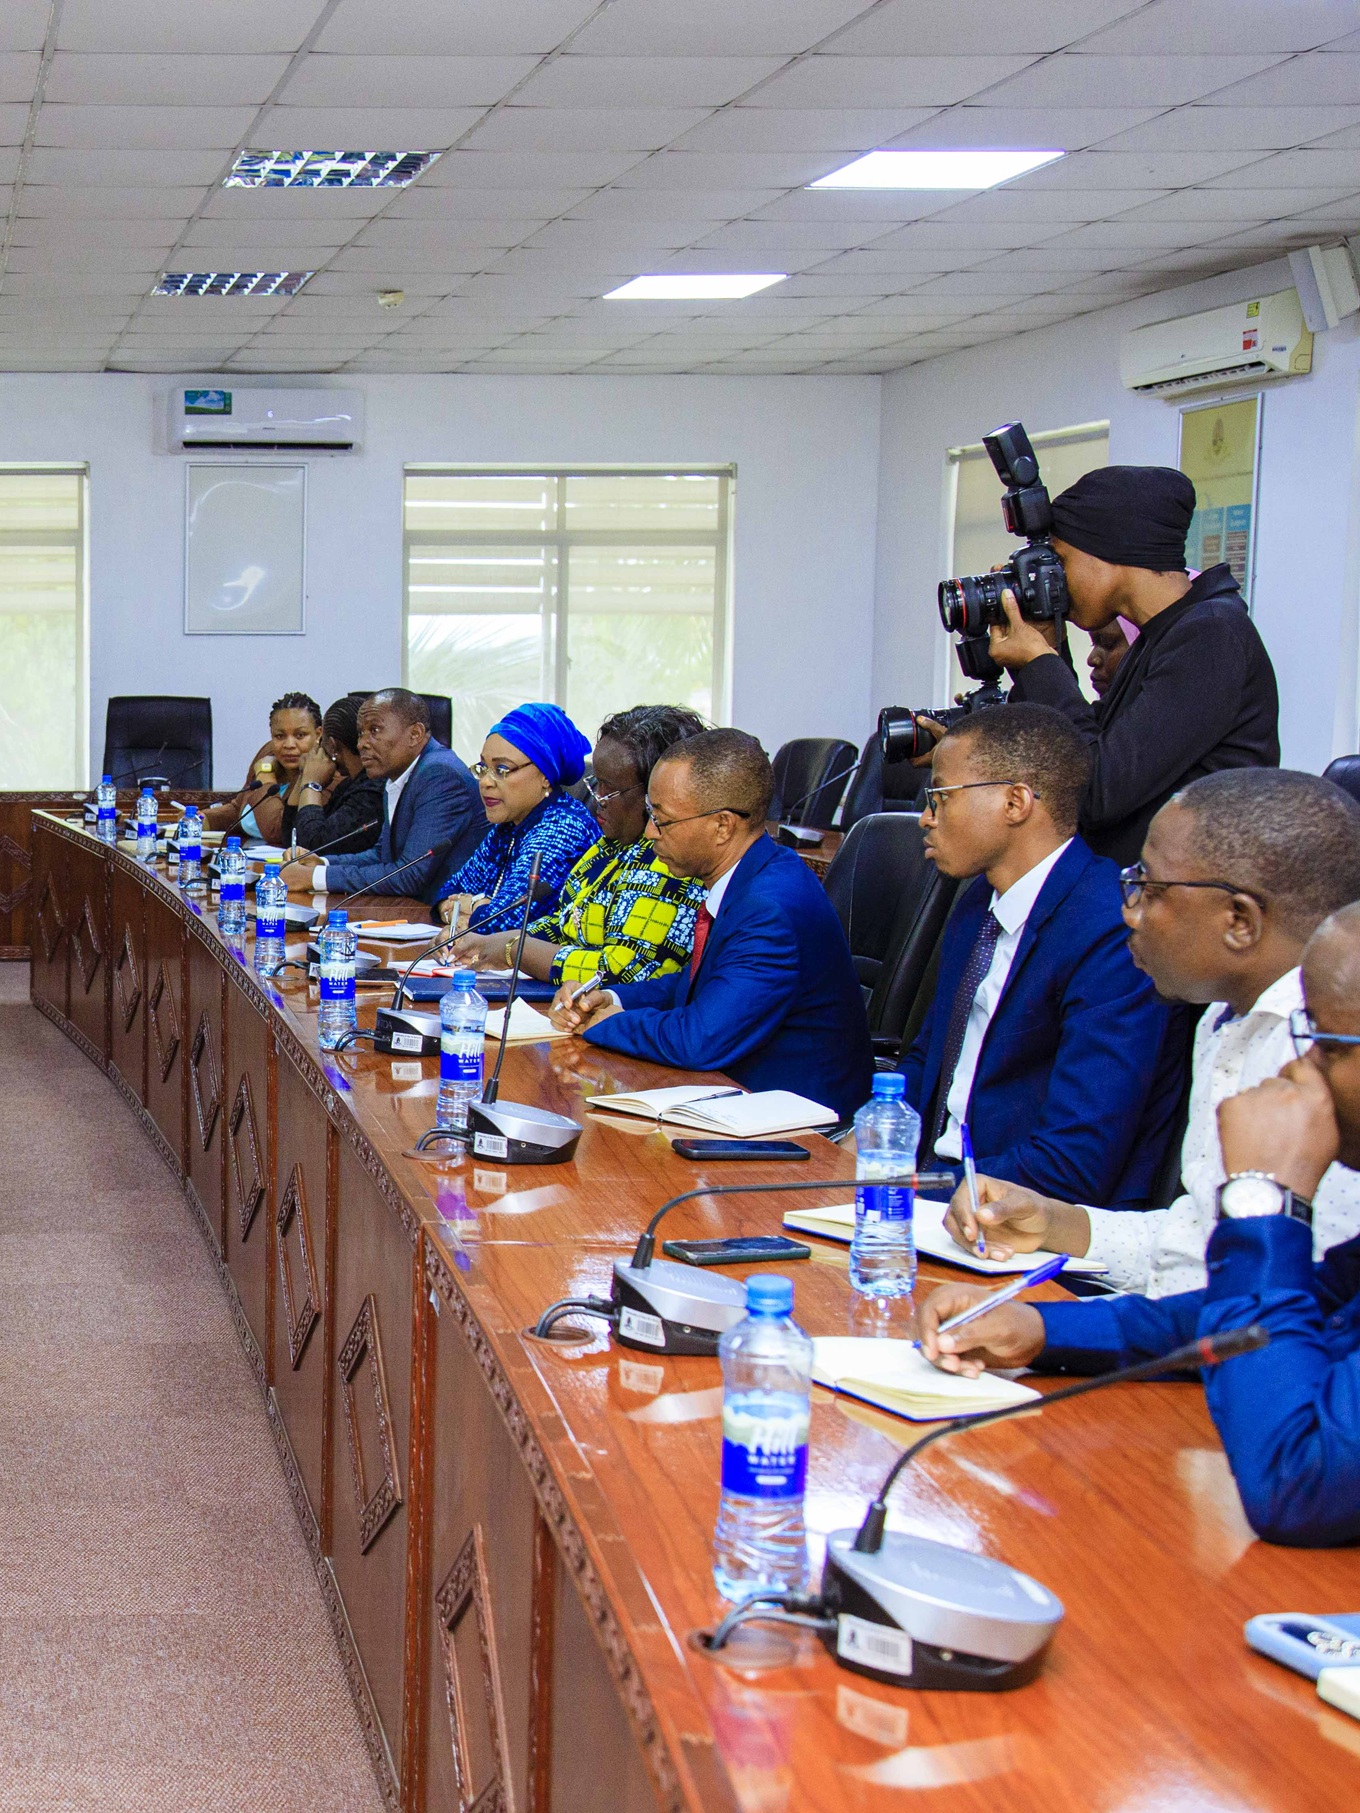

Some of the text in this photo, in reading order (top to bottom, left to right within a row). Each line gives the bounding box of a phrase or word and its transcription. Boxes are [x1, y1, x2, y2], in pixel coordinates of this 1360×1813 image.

[262, 911, 278, 922] Hill
[329, 969, 348, 981] Hill
[459, 1042, 481, 1059] Hill
[748, 1423, 798, 1455] Hill
